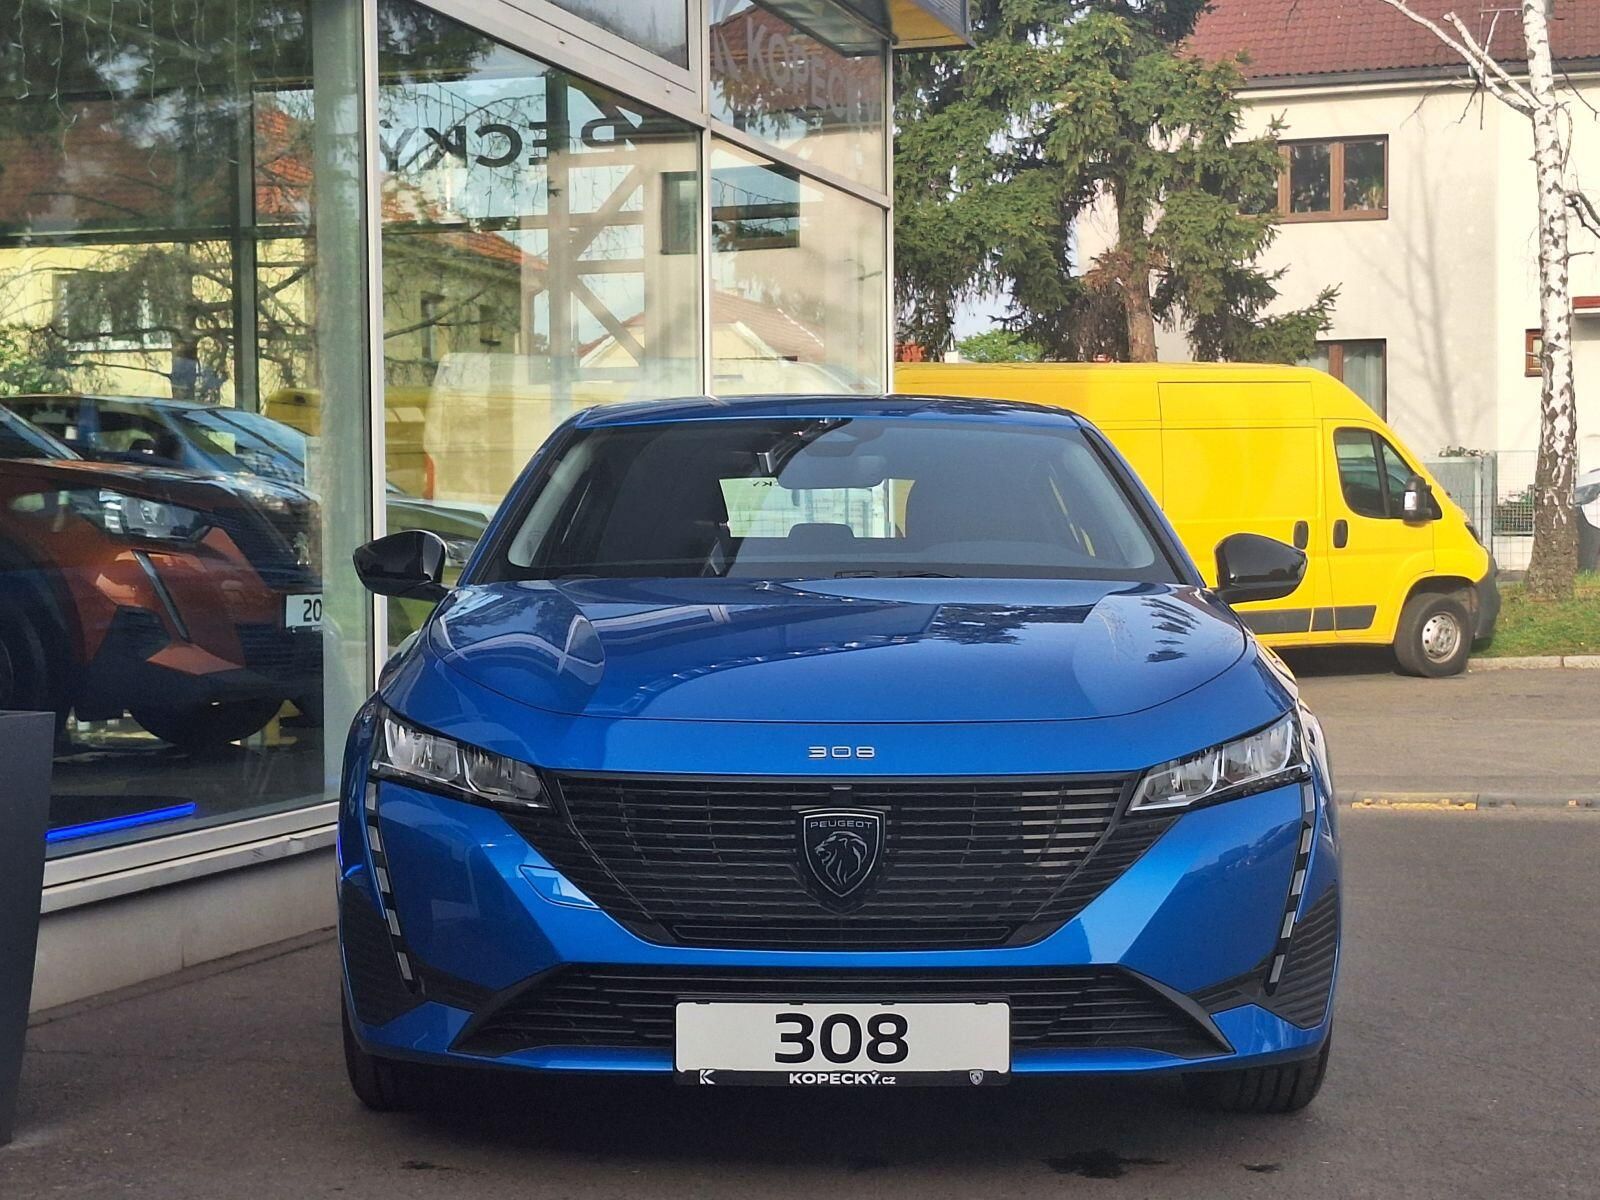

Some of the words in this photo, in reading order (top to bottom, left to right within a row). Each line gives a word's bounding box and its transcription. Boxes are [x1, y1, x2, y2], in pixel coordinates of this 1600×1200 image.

[808, 746, 876, 758] 308
[810, 821, 873, 829] PEUGEOT
[775, 1013, 909, 1064] 308
